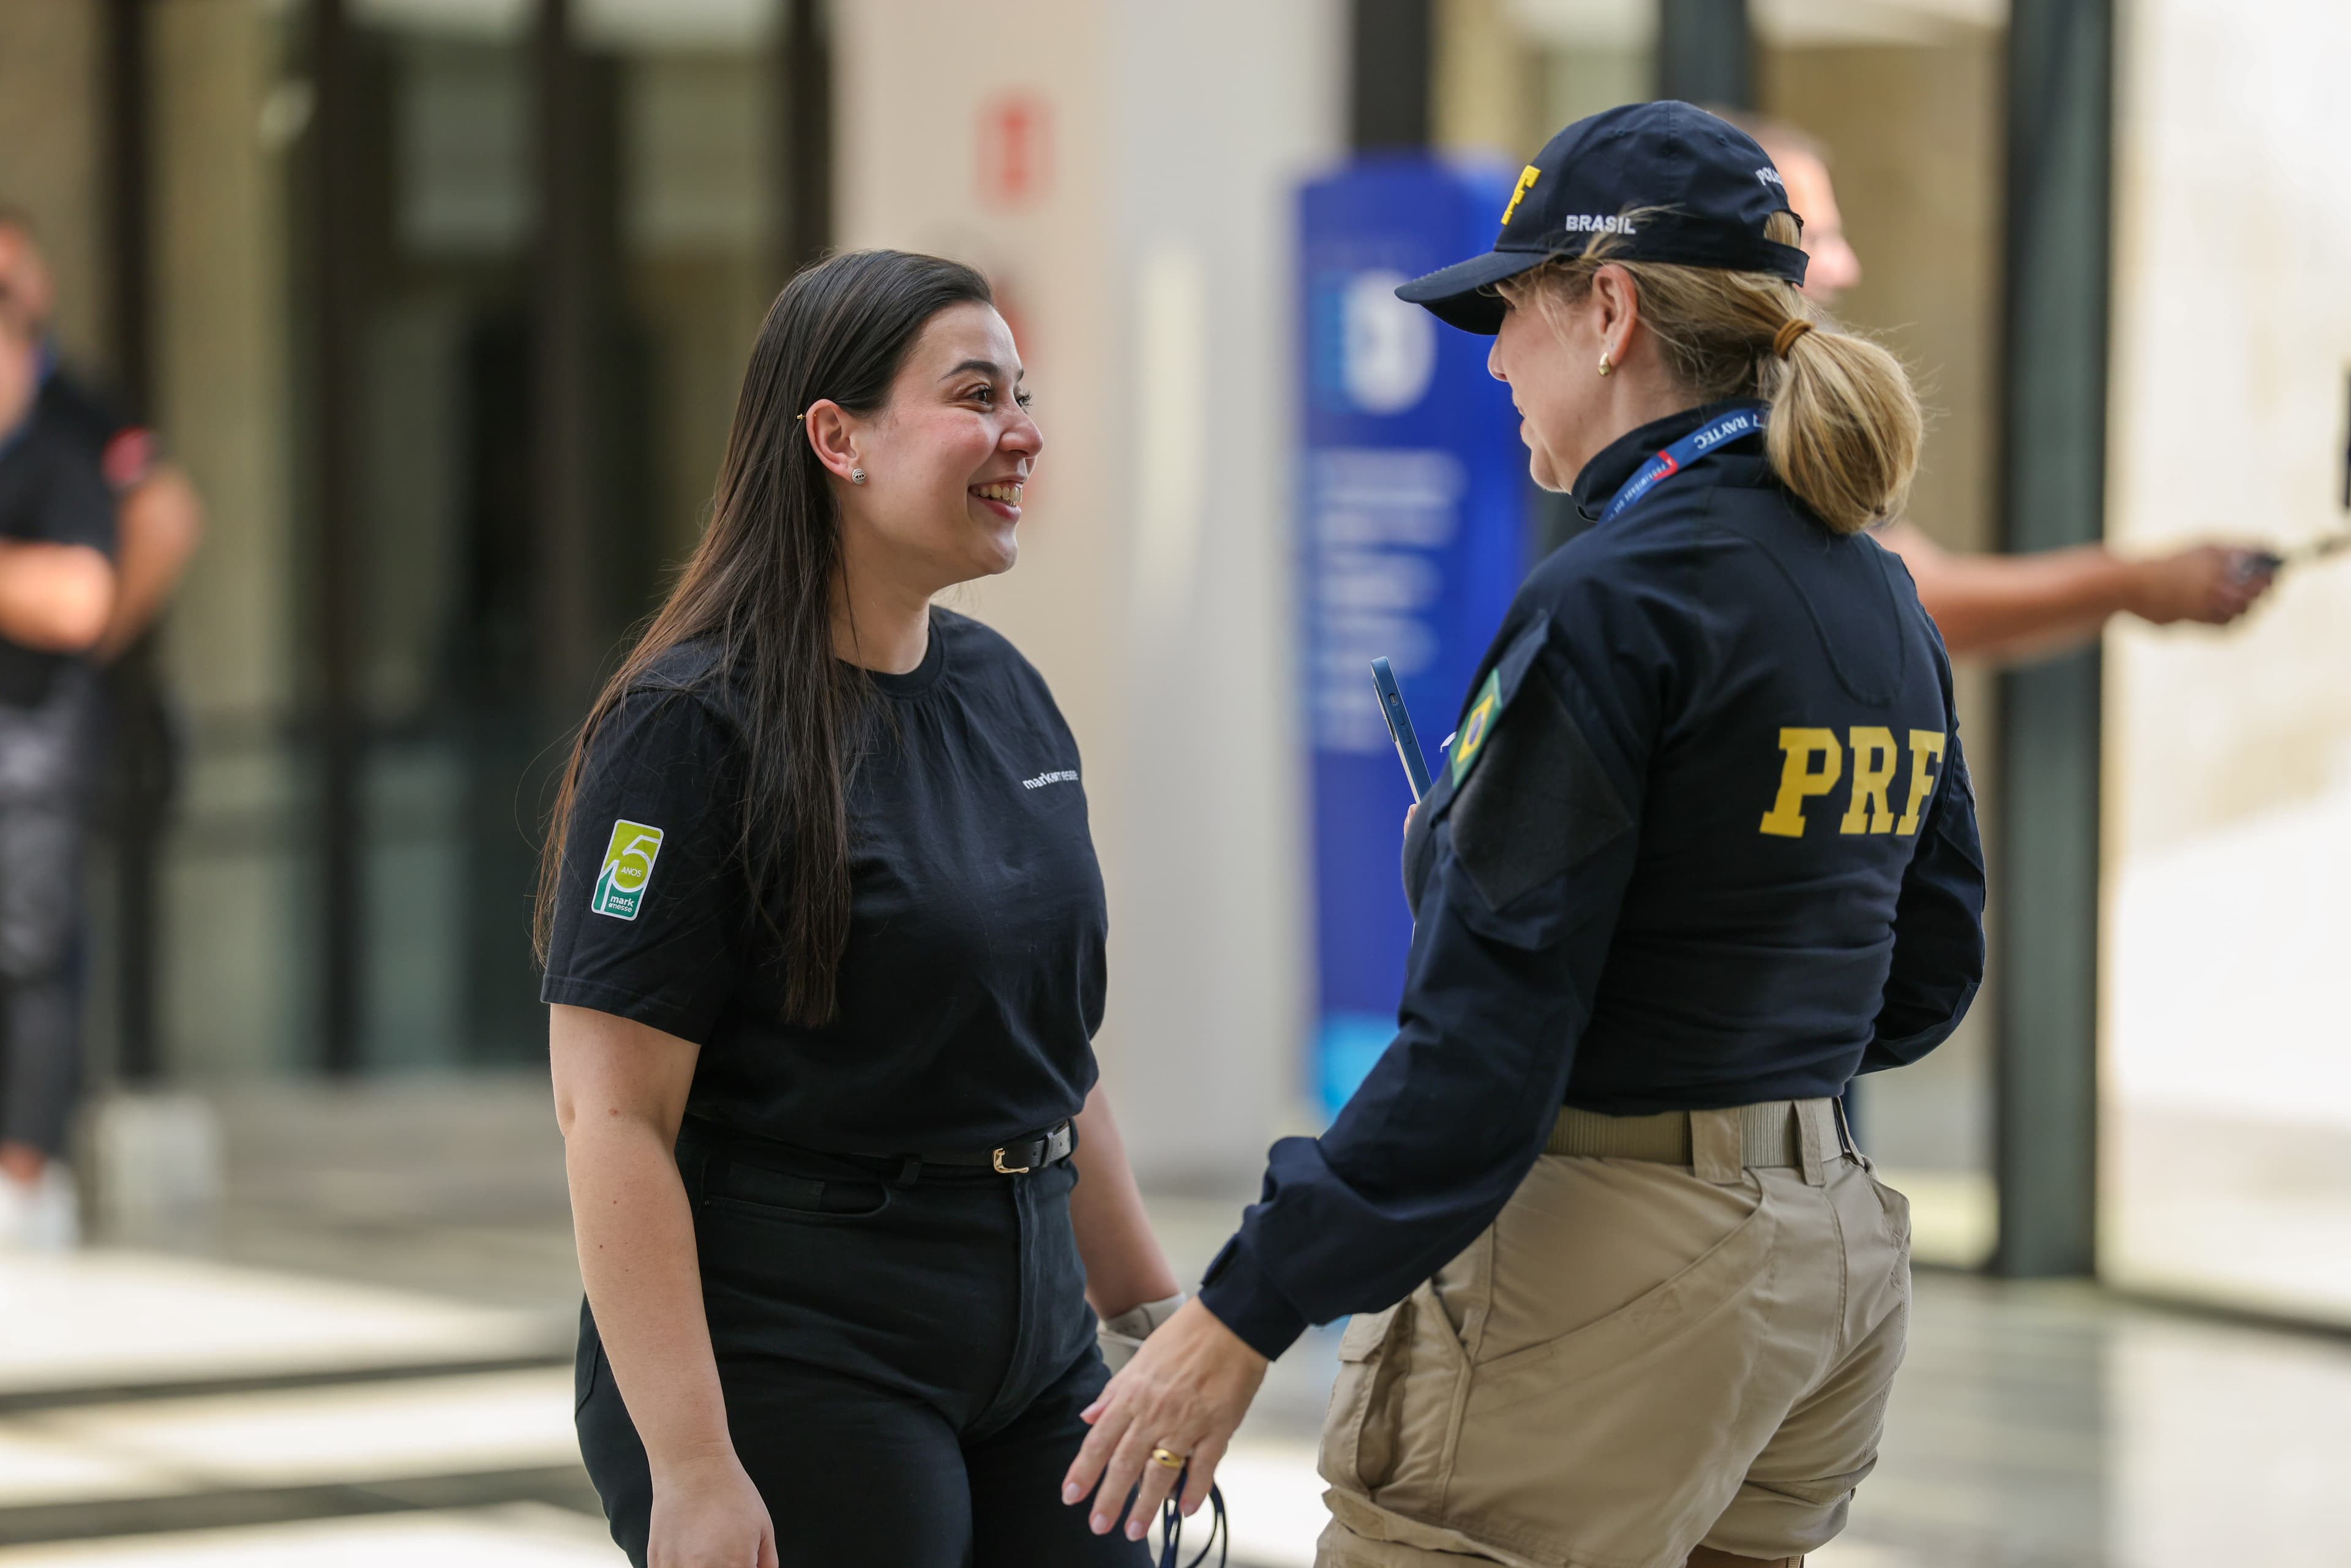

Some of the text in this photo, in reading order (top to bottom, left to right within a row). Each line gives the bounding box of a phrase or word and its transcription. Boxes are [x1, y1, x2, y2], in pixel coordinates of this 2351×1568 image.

[1565, 214, 1637, 235] BRASIL
[1694, 416, 1749, 449] RAYTEC
[1759, 726, 1945, 838] PRF
[621, 866, 642, 878] ANOS
[610, 896, 635, 907] mark
